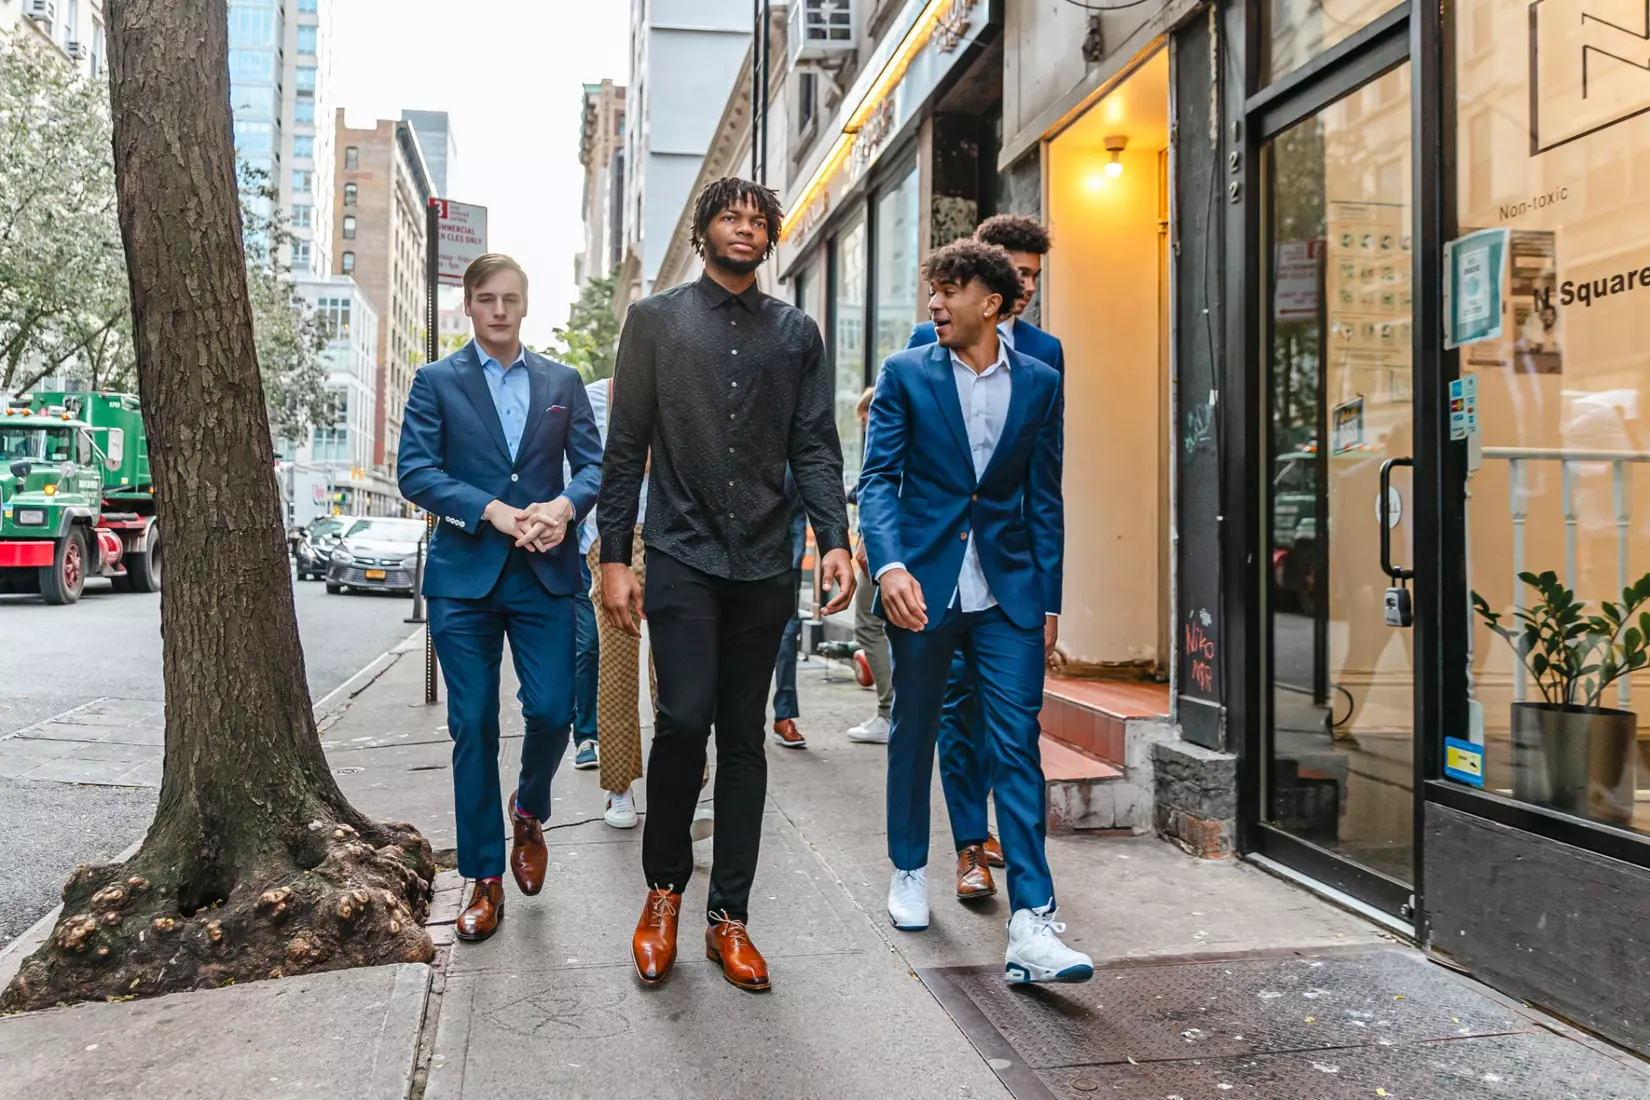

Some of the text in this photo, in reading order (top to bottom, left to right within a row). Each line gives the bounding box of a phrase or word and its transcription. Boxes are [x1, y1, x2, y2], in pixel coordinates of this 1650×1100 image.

[1500, 186, 1569, 221] Non-toxic
[465, 236, 482, 245] ONLY
[1560, 266, 1650, 307] Square
